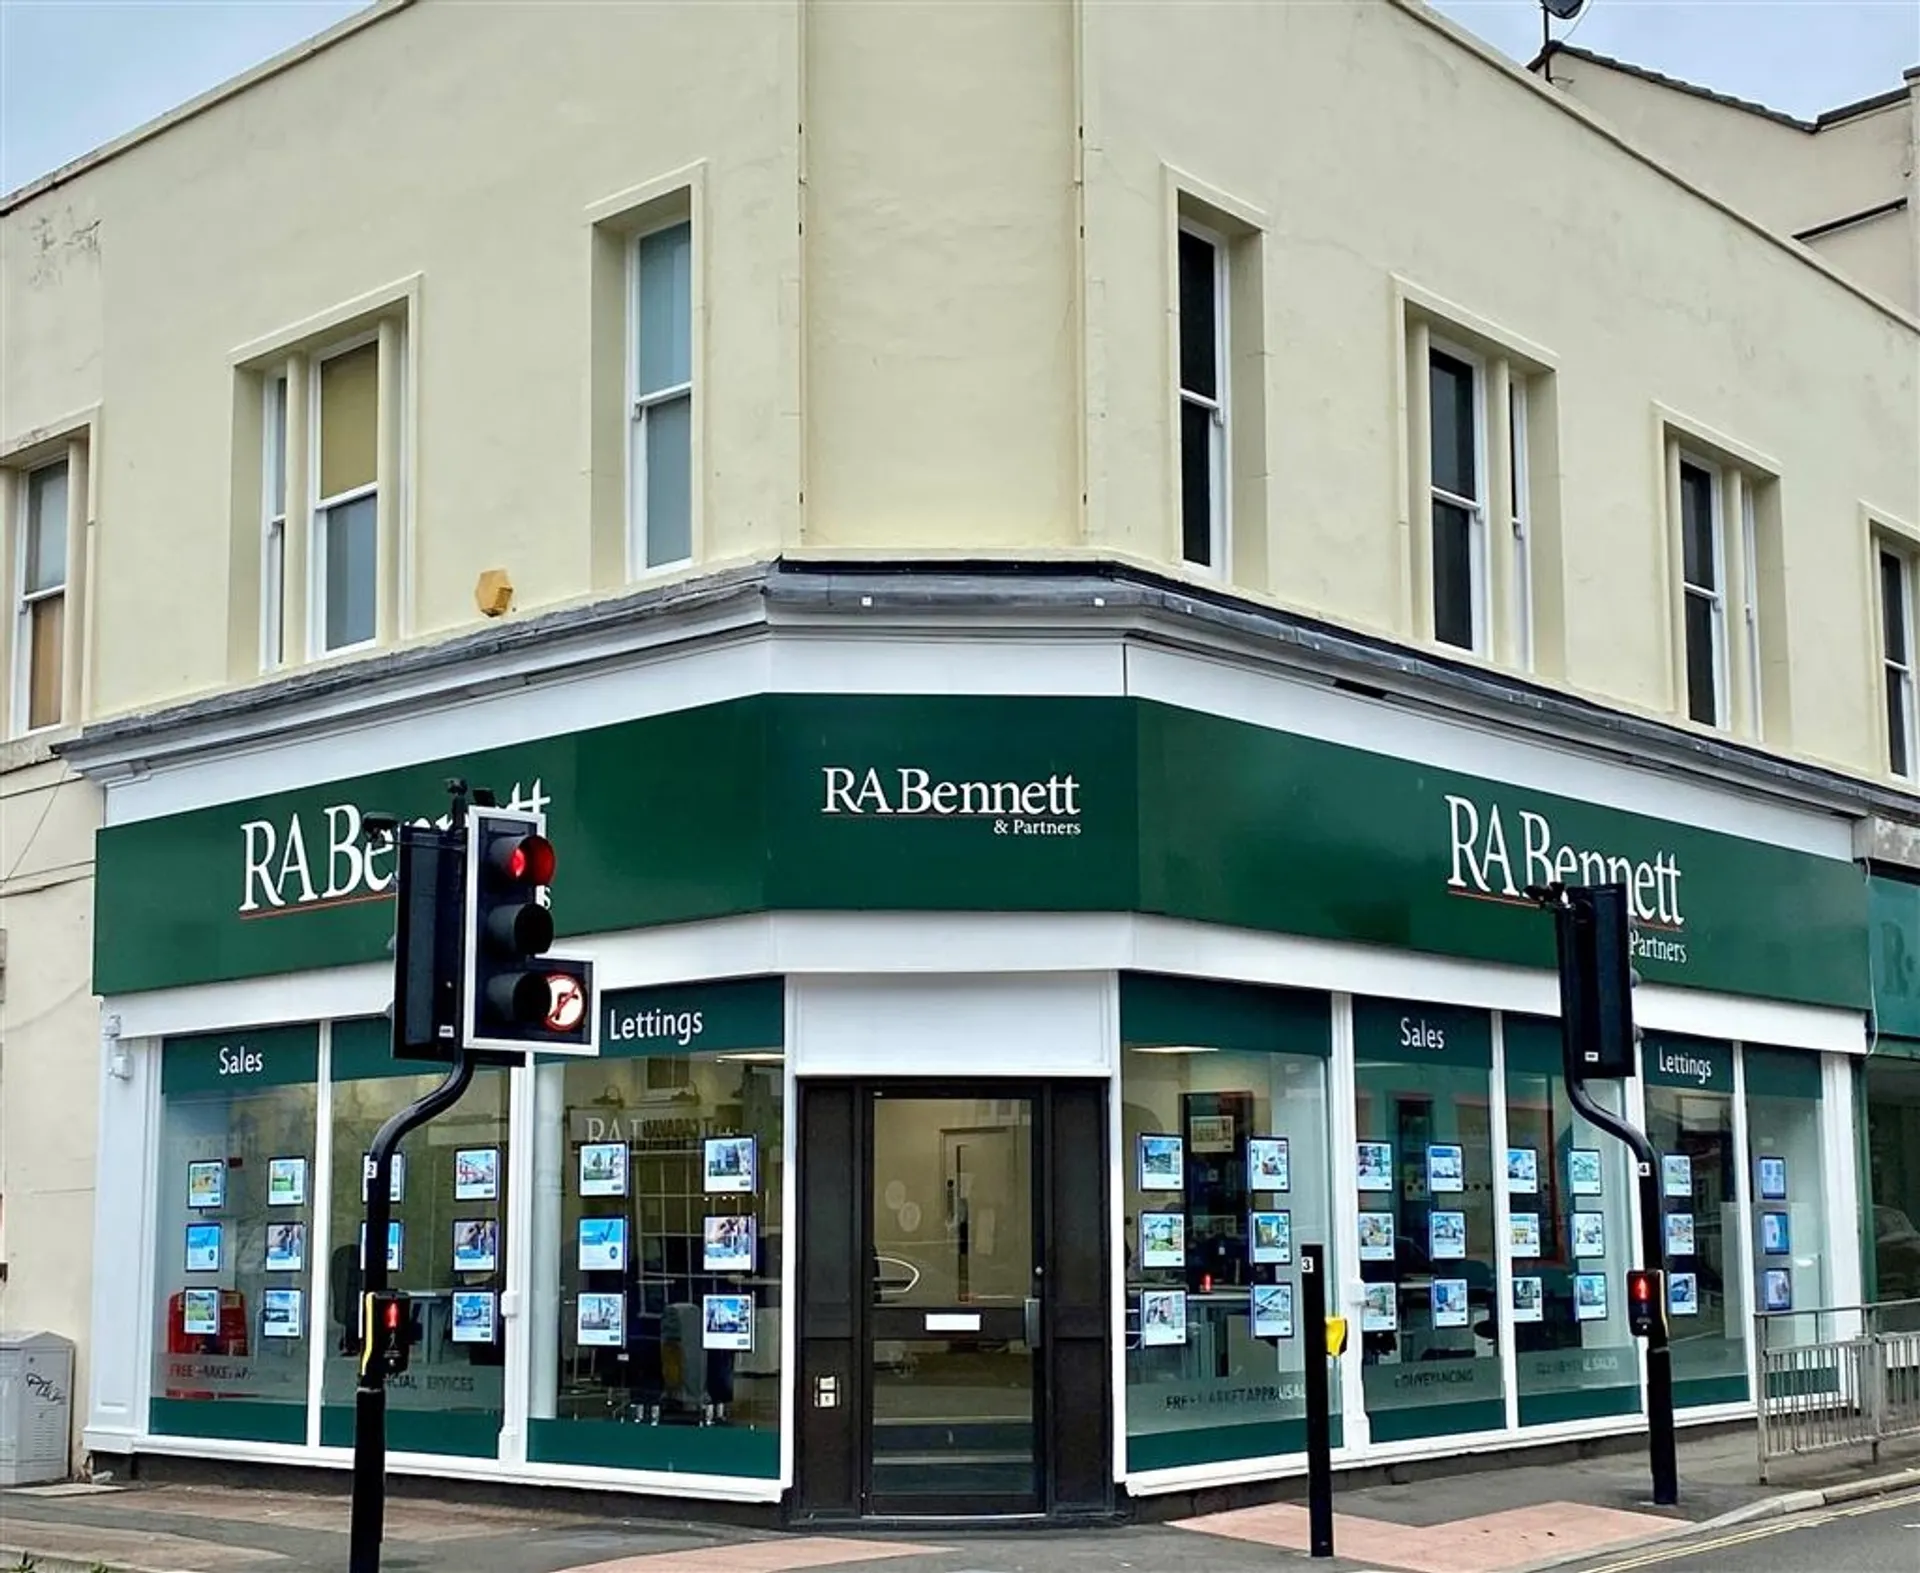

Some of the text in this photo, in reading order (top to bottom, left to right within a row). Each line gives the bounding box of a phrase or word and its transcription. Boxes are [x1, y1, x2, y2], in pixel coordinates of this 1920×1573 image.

[822, 767, 1081, 815] RA Bennett
[993, 819, 1081, 836] & Partners
[238, 813, 318, 911] RA
[1444, 795, 1520, 896] RA
[1631, 930, 1687, 963] Partners
[610, 1008, 703, 1045] Lettings
[1400, 1017, 1444, 1049] Sales
[219, 1046, 263, 1075] Sales
[1659, 1045, 1712, 1085] Lettings
[1303, 1258, 1310, 1271] 3
